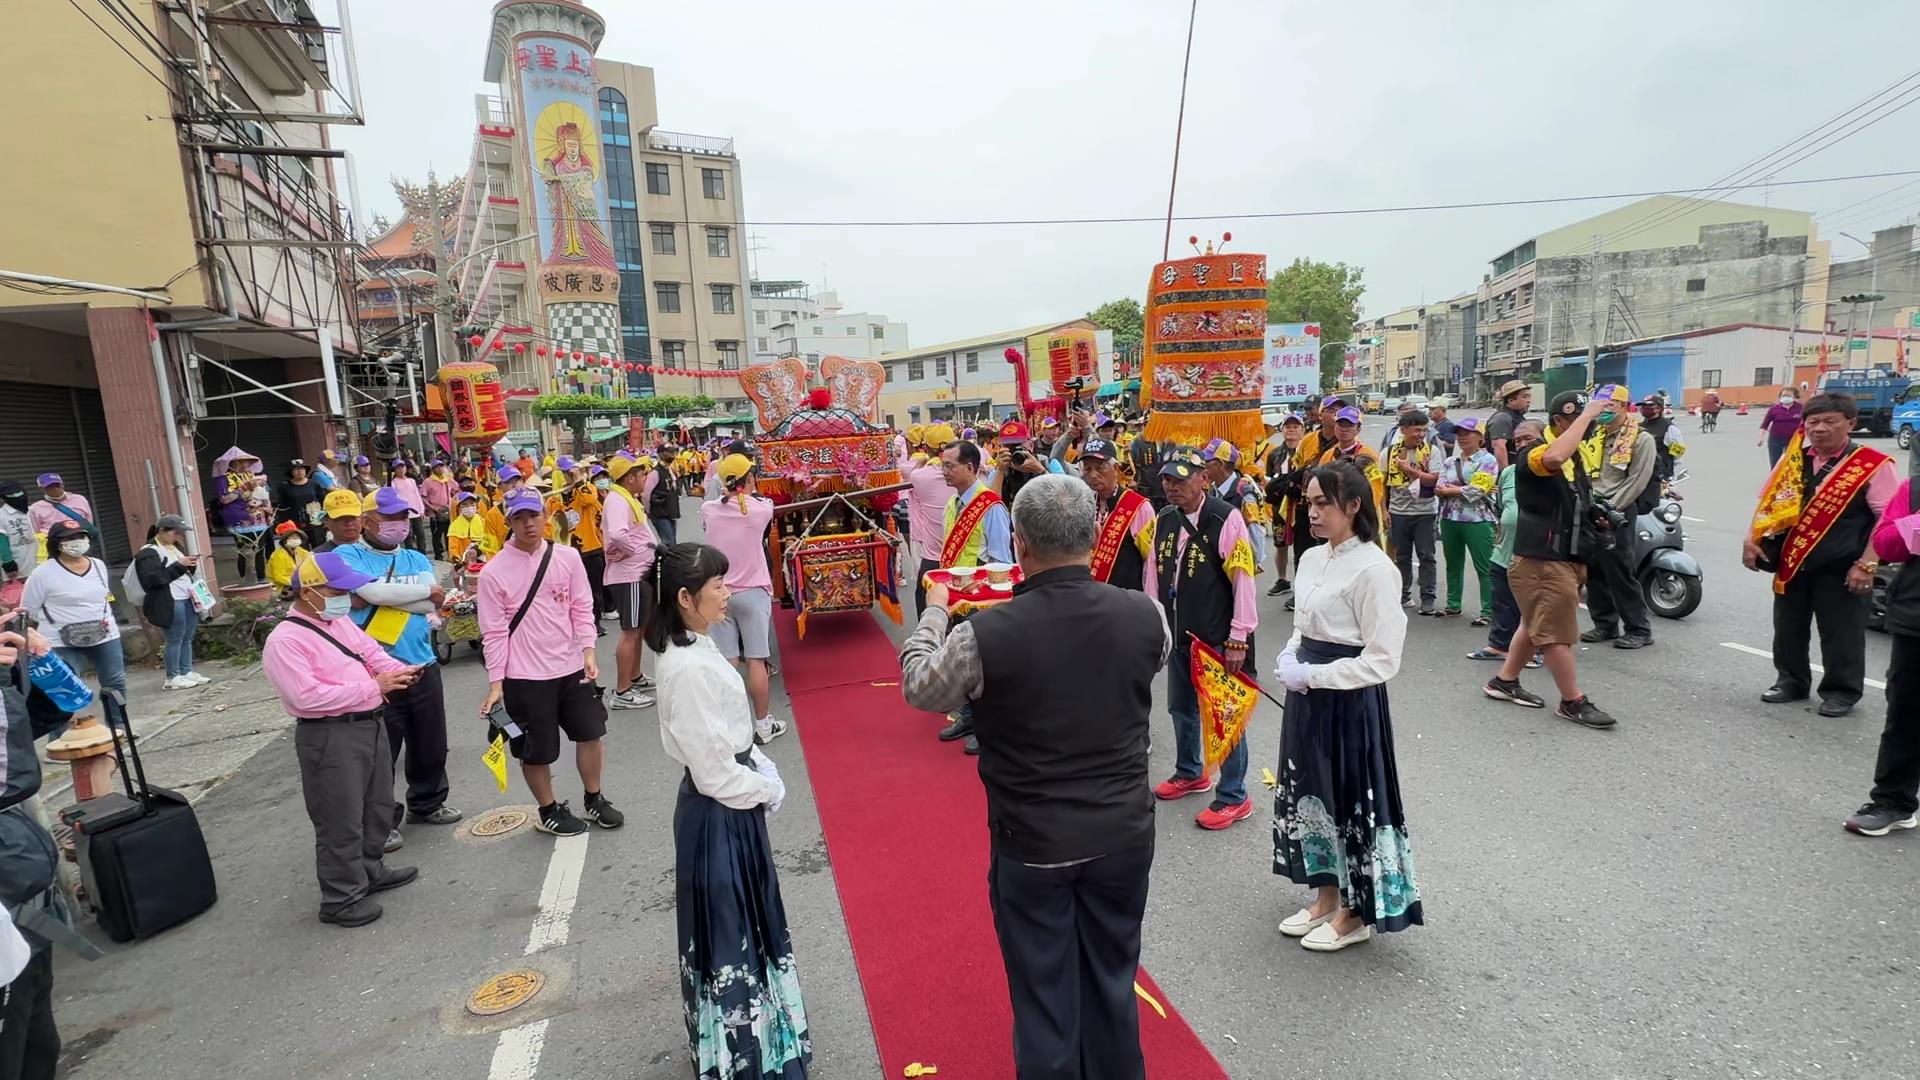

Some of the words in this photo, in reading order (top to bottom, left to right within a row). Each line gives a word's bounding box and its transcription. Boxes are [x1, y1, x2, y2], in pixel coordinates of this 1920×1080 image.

[516, 44, 591, 77] 上聖母
[1272, 383, 1308, 397] 王秋足
